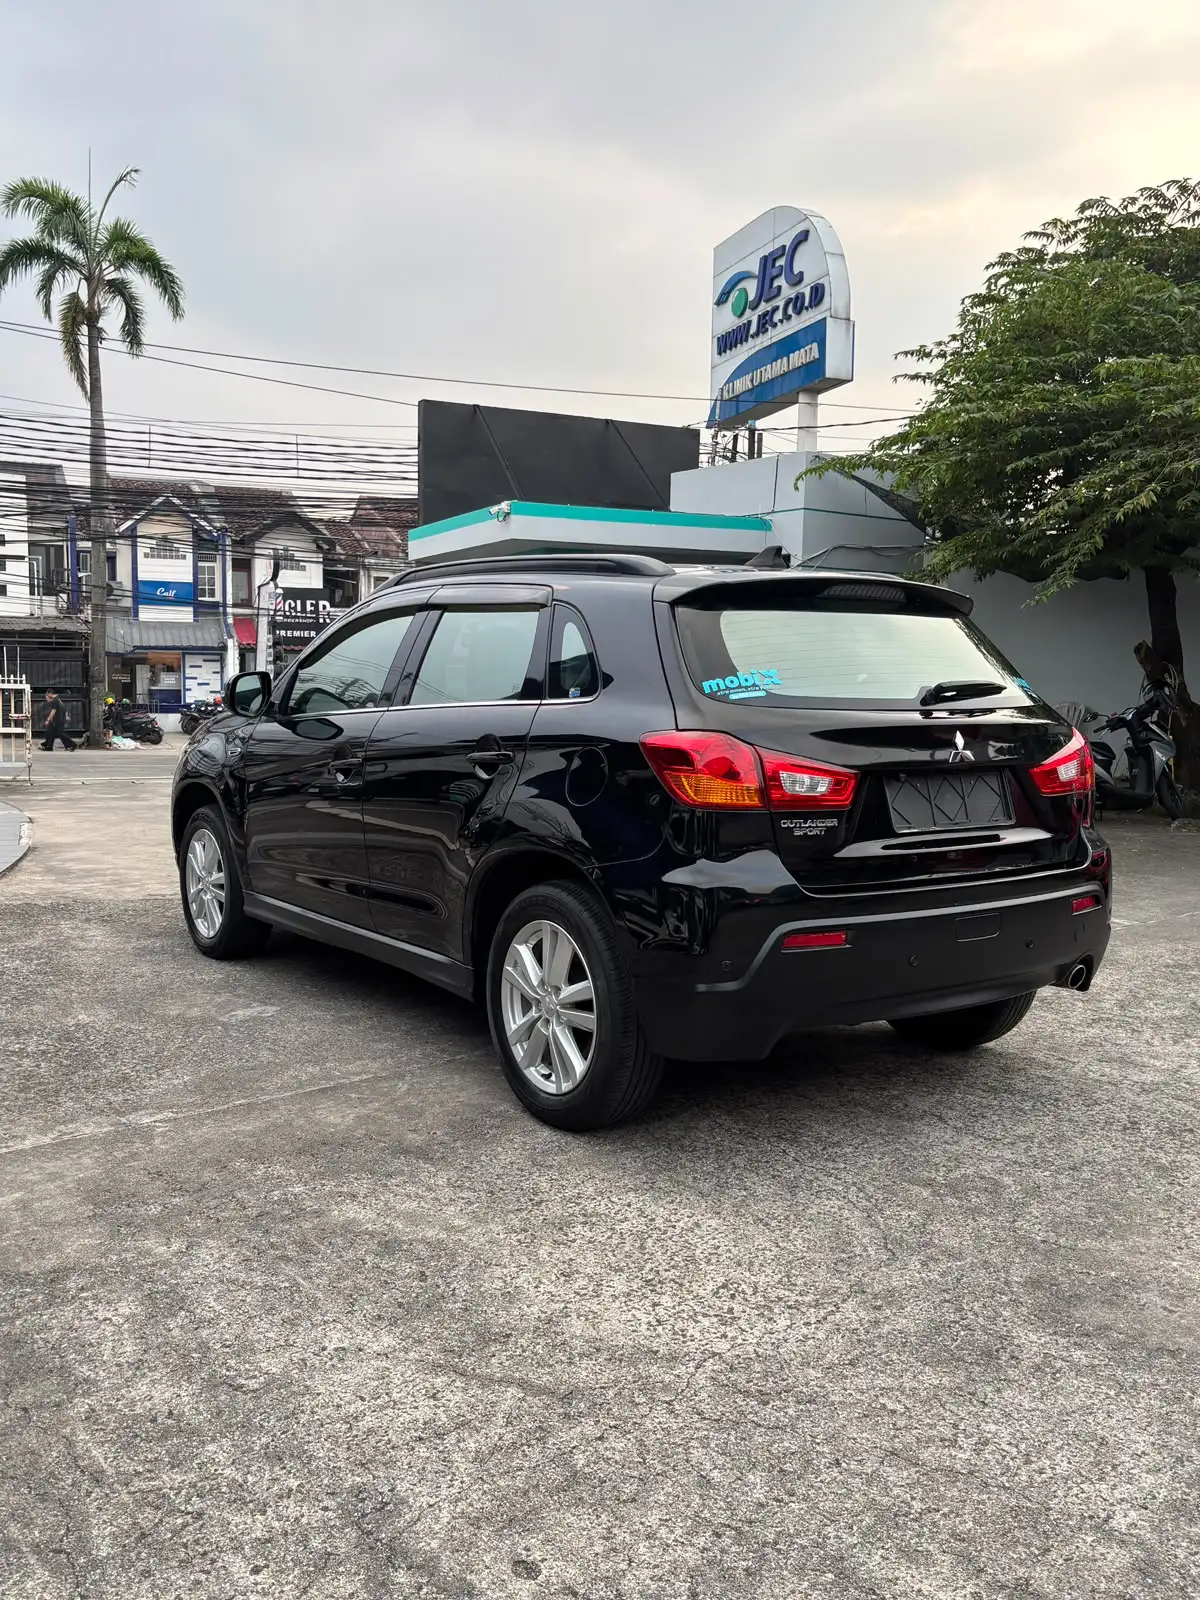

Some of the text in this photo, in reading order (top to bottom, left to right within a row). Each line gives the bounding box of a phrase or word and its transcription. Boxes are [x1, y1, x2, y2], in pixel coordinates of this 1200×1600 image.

[748, 229, 810, 311] JEC
[716, 282, 826, 356] WWW.JEC.CO.ID
[722, 342, 820, 400] KLINIK UTAMA MATA
[780, 818, 838, 828] OUTLANDER
[793, 827, 827, 836] SPORT
